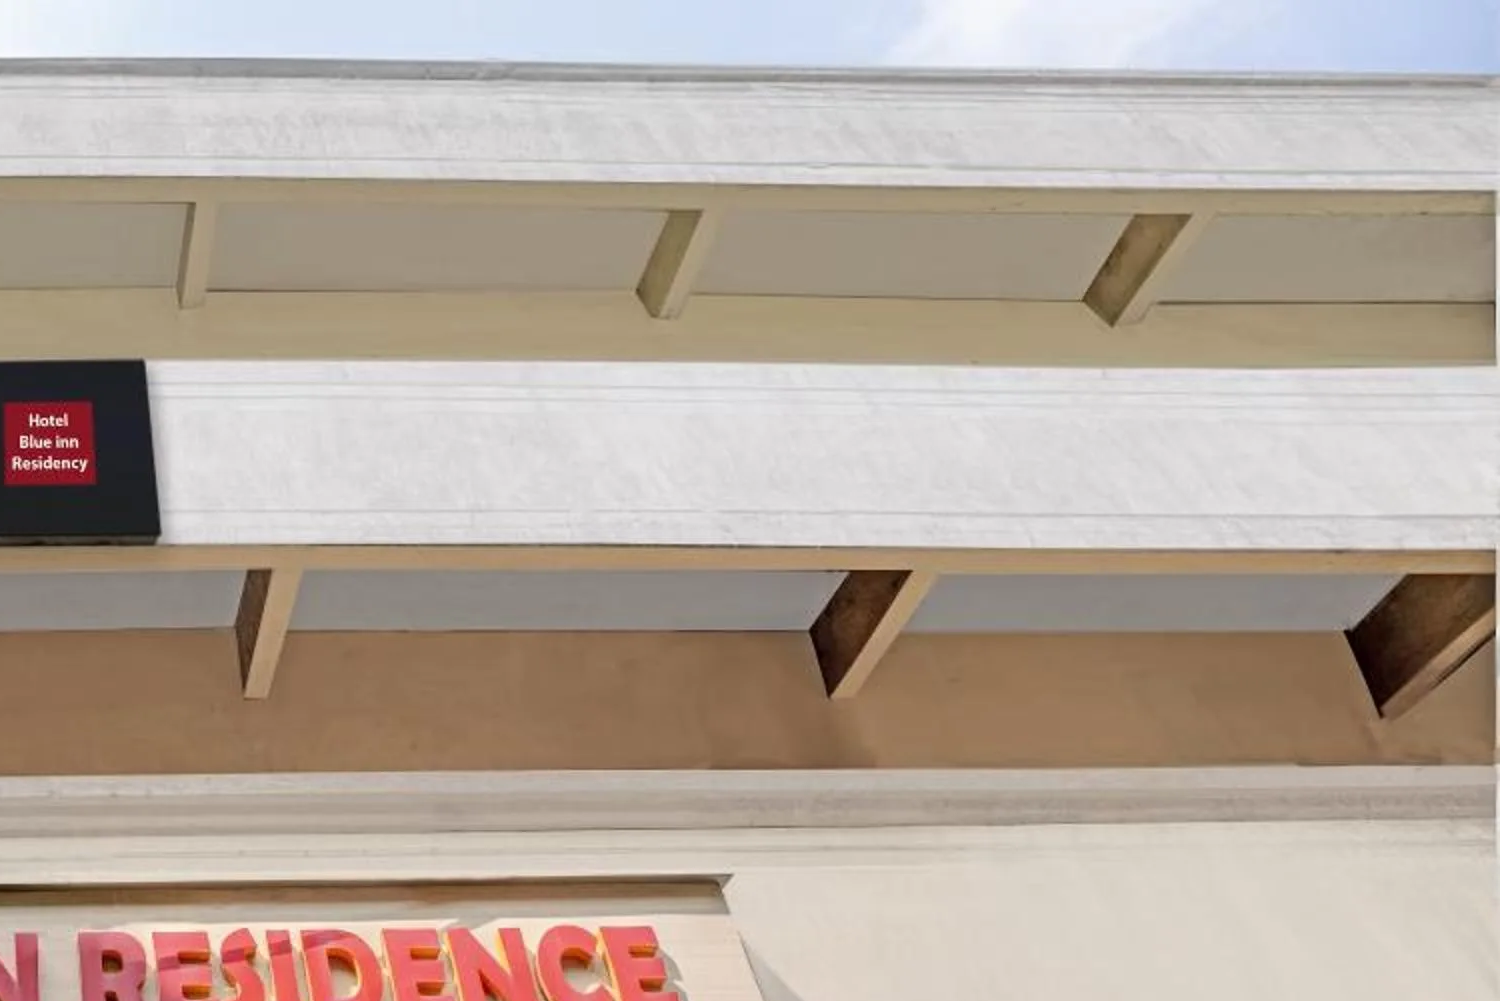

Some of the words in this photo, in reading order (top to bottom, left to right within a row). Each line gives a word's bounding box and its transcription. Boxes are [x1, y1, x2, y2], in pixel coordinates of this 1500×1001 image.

[29, 413, 69, 427] Hotel
[19, 435, 52, 449] Blue
[55, 435, 79, 449] inn
[11, 456, 88, 473] Residency
